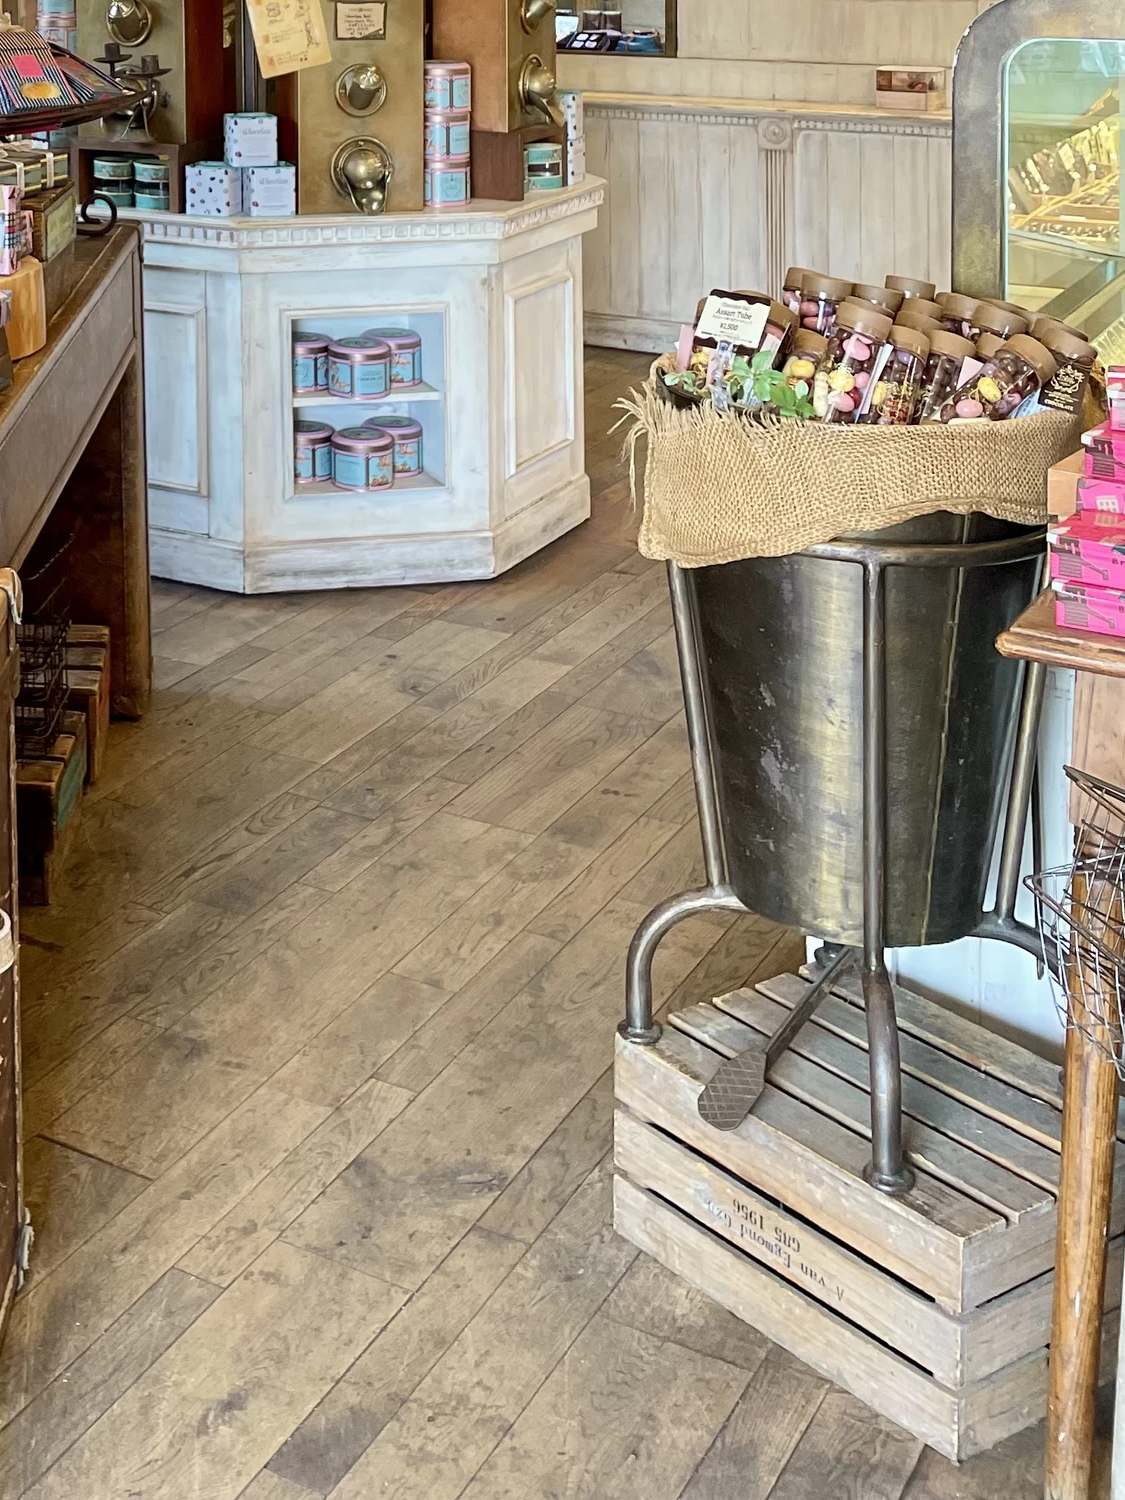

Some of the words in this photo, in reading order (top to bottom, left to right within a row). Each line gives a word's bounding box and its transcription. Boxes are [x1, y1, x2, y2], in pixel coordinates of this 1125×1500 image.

[737, 311, 753, 320] Tube
[732, 1198, 764, 1230] 1956
[740, 1223, 791, 1269] Egmond
[800, 1262, 826, 1287] van
